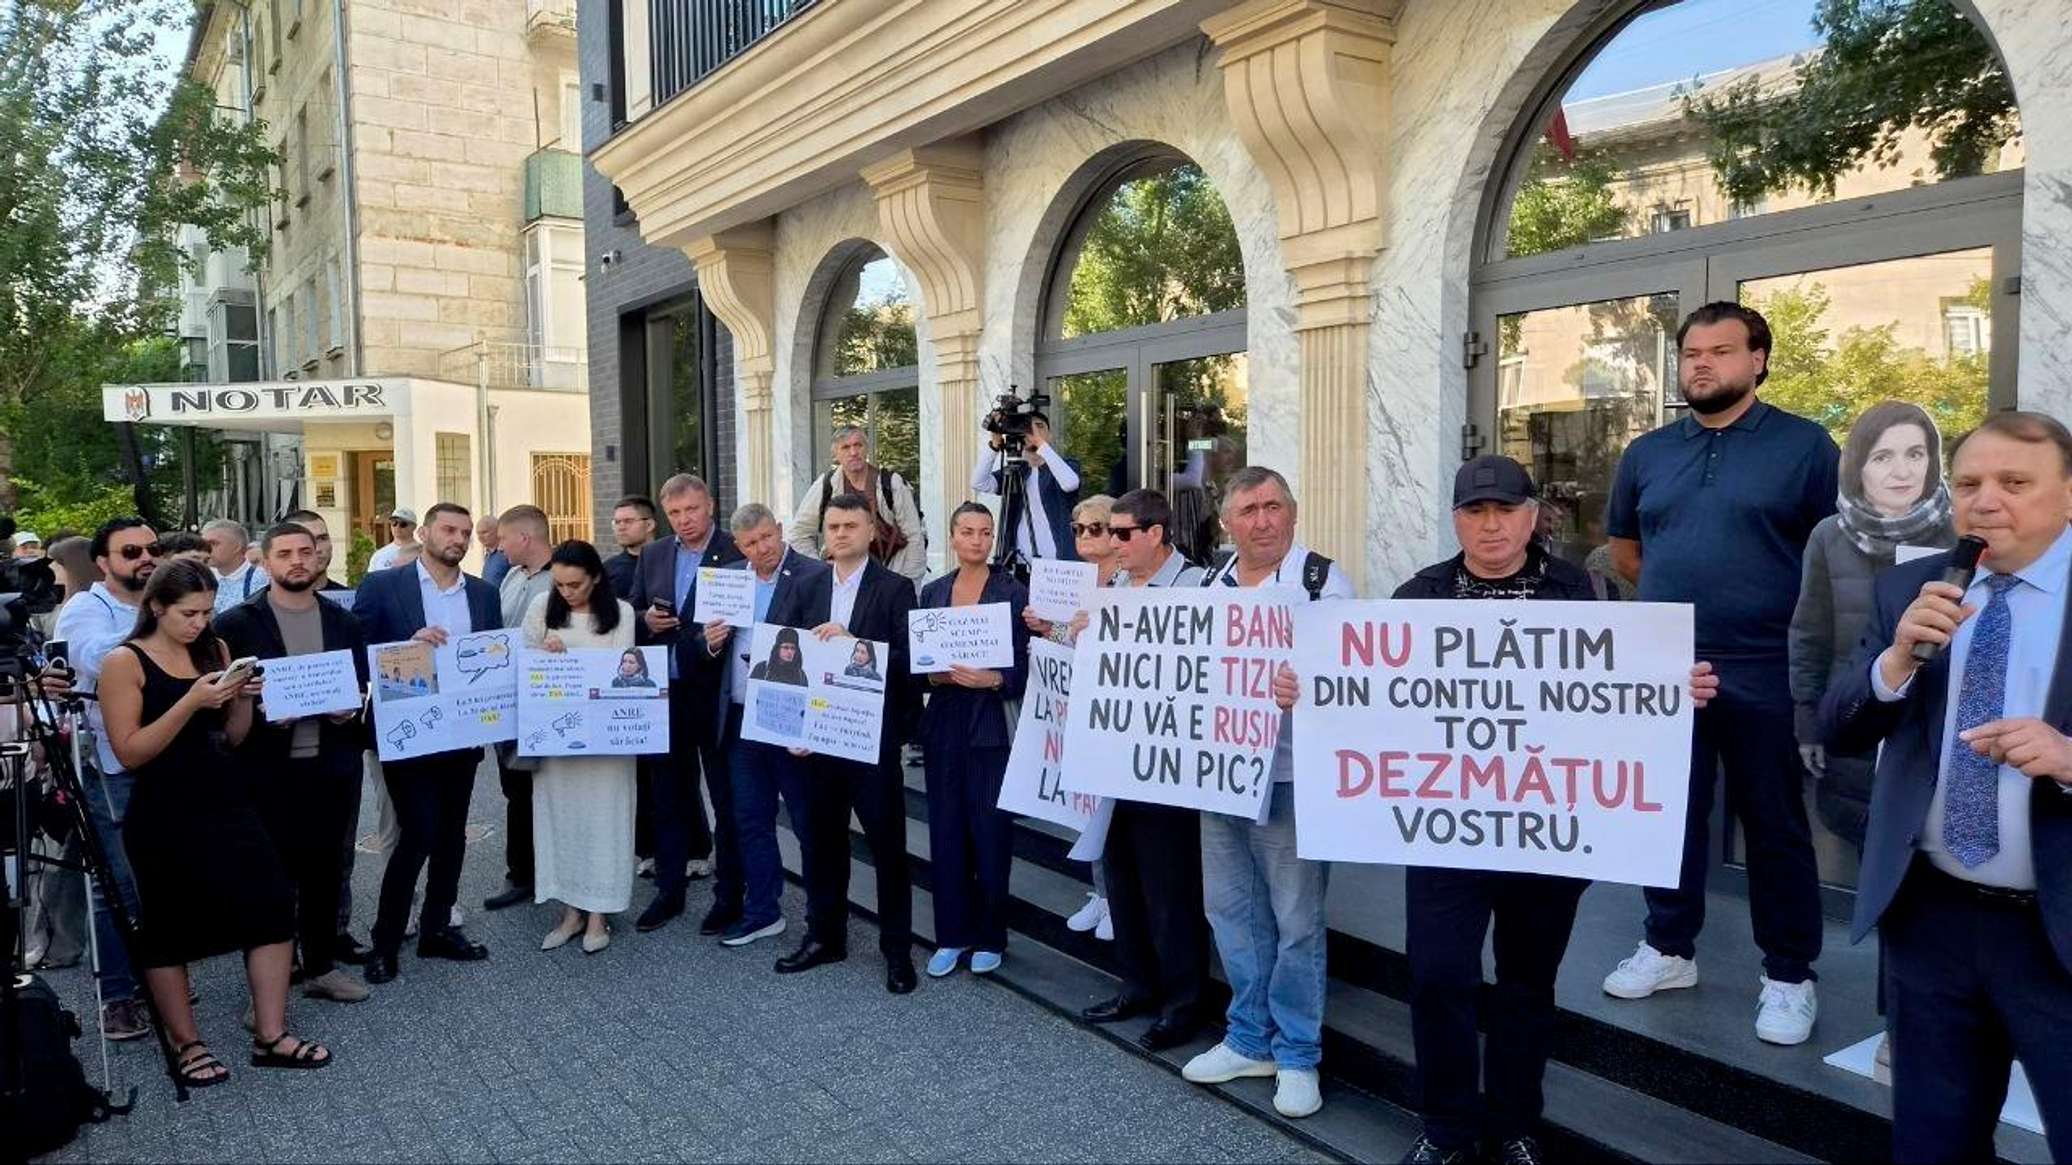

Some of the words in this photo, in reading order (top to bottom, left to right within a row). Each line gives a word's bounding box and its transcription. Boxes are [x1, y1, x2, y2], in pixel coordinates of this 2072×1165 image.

[171, 384, 385, 412] NOTAR
[1099, 605, 1214, 645] N-AVEM
[1341, 621, 1412, 667] NU
[1435, 618, 1615, 671] PLĂTIM
[1098, 652, 1162, 690] NICI
[1175, 655, 1210, 694] DE
[1035, 692, 1053, 722] LA
[1314, 676, 1370, 706] DIN
[1388, 677, 1524, 711] CONTUL
[1540, 681, 1680, 716] NOSTRU
[1089, 698, 1132, 732] NU
[1144, 696, 1178, 737] VĂ
[1190, 705, 1204, 740] E
[1435, 716, 1527, 751] TOT
[1044, 729, 1064, 763] N
[1038, 767, 1066, 806] LA
[1133, 743, 1181, 785] UN
[1197, 750, 1265, 797] PIC?
[1335, 744, 1663, 812] DEZMĂȚUL
[1393, 806, 1593, 854] VOSTRU.
